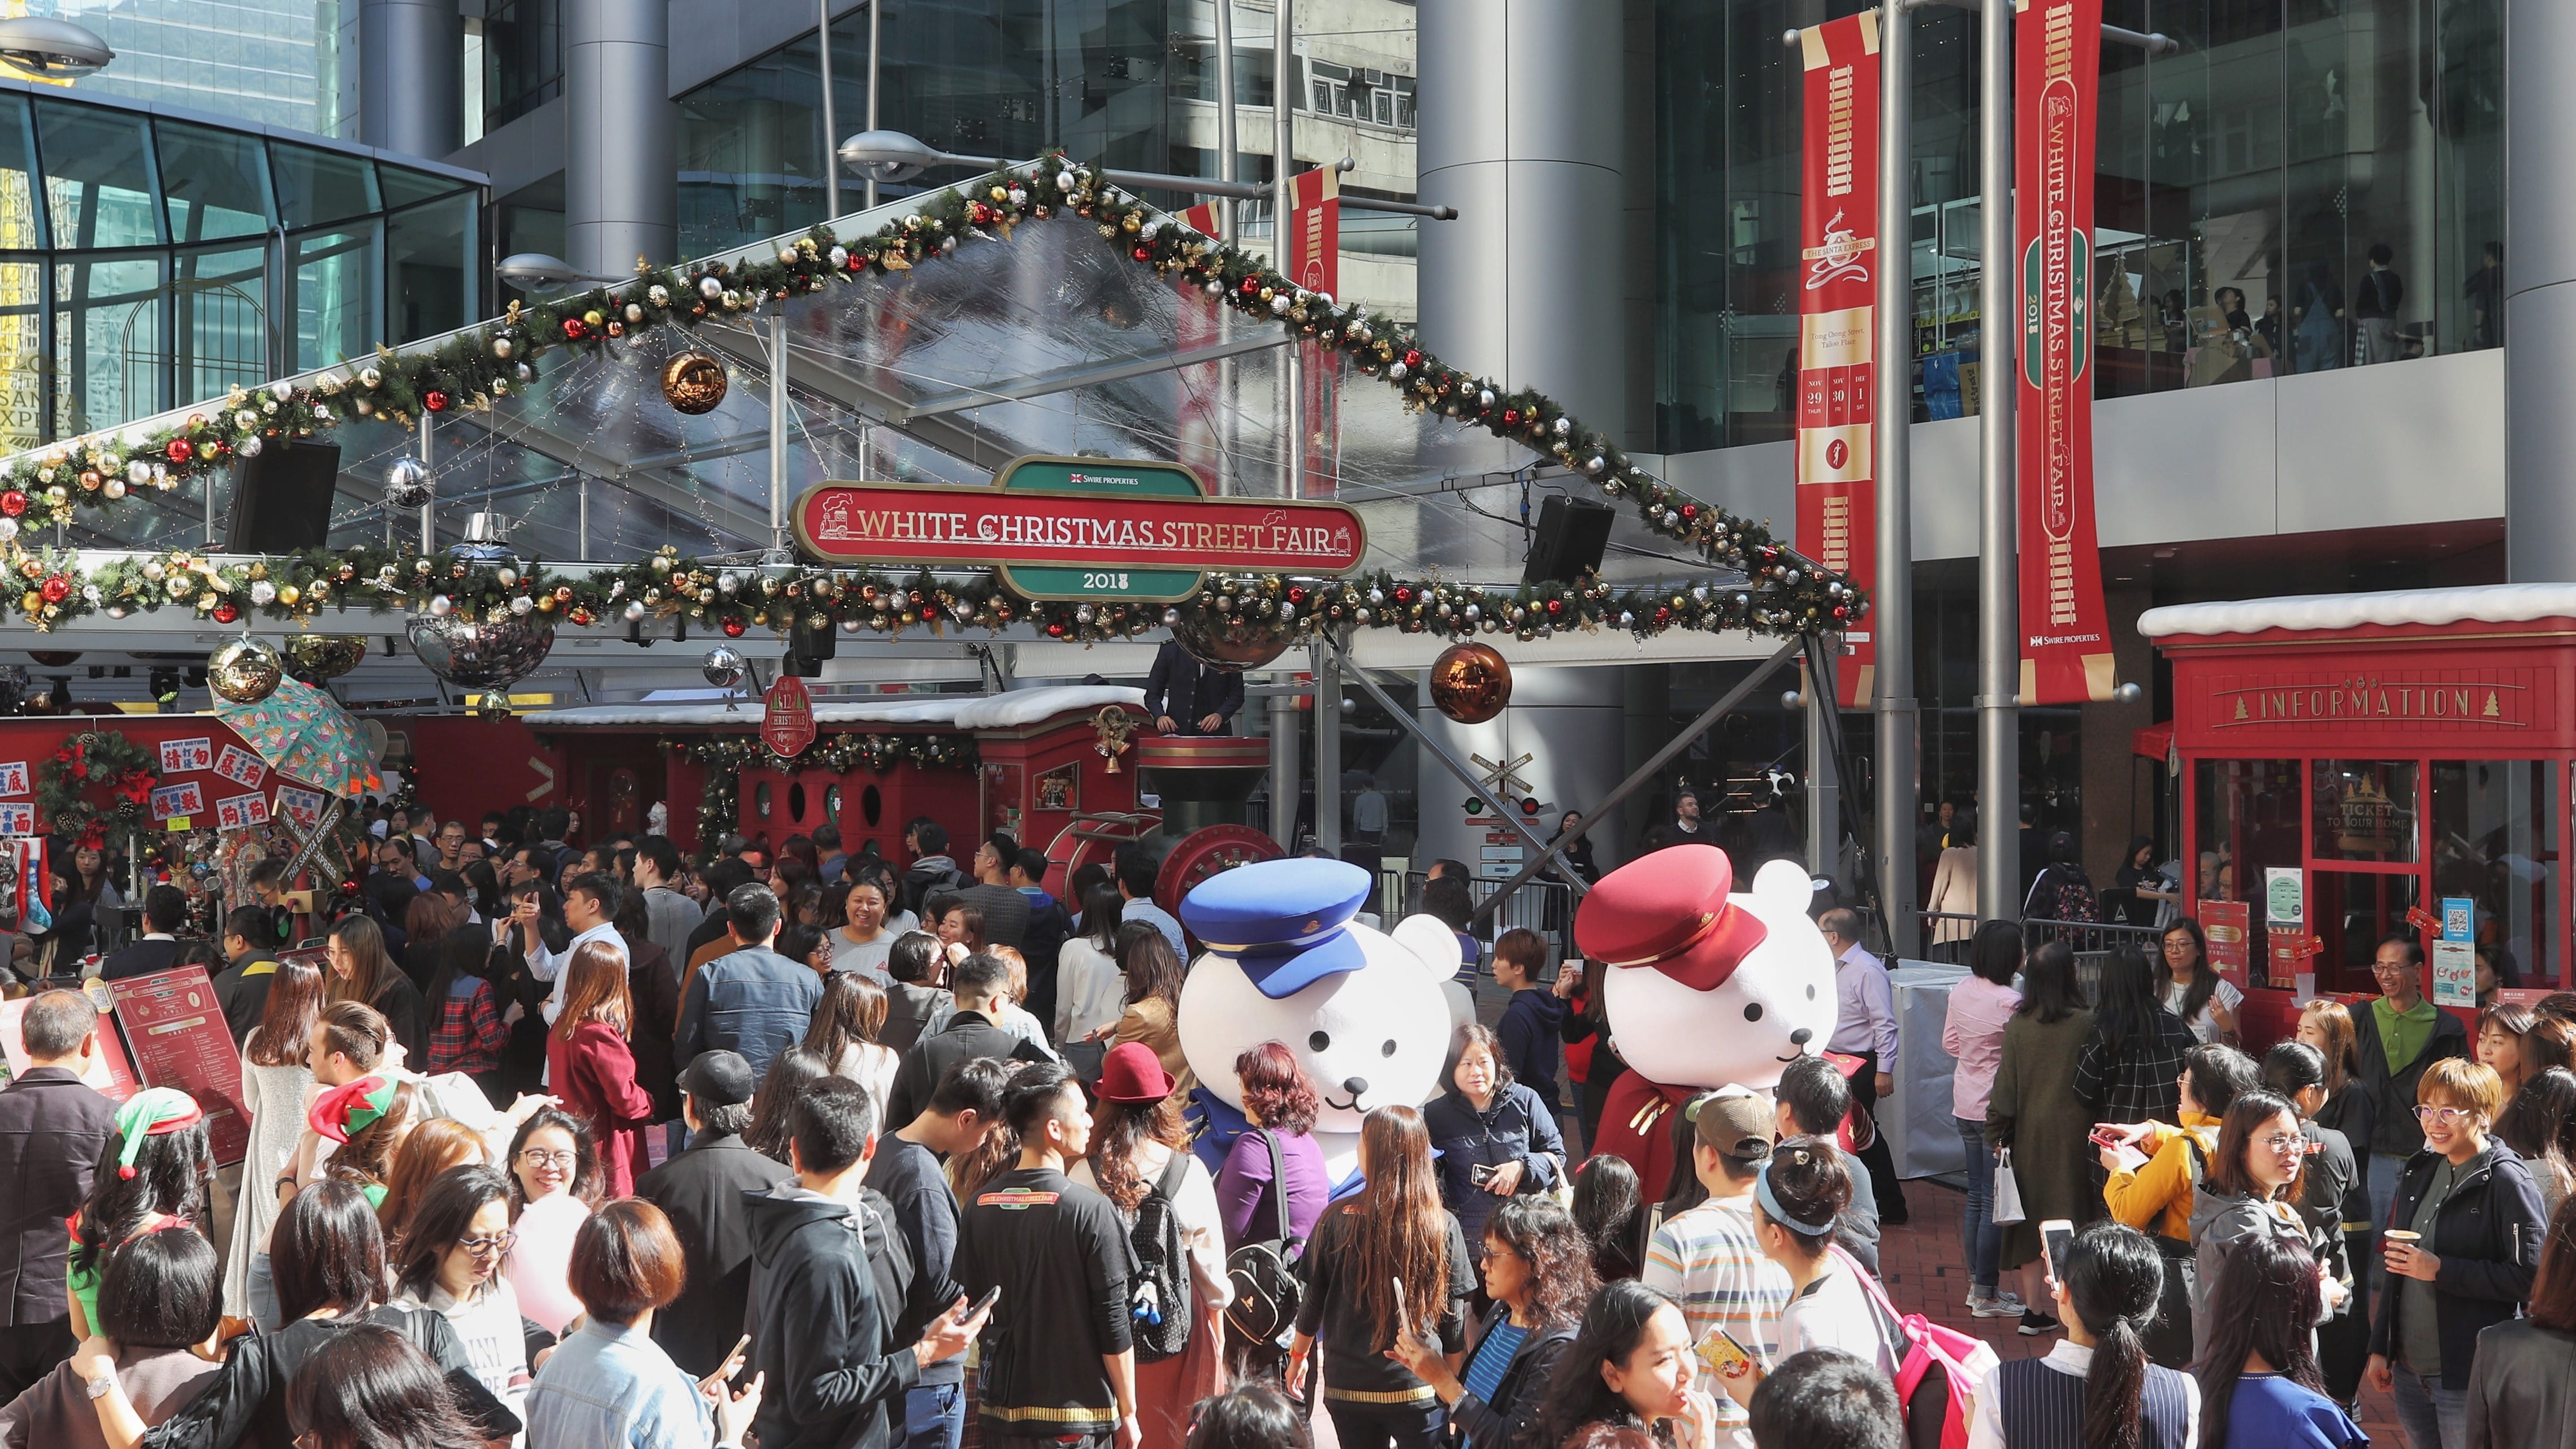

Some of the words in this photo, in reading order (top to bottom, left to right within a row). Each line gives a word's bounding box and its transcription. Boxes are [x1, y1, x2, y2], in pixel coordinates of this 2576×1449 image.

[2050, 121, 2064, 204] WHITE
[1822, 246, 1842, 255] SANTA
[1844, 240, 1871, 251] EXPRESS
[2050, 210, 2064, 353] CHRISTMAS
[1828, 329, 1846, 338] Chong
[0, 389, 80, 411] SANTA
[1807, 392, 1822, 405] 29
[1833, 389, 1845, 402] 30
[1858, 388, 1863, 400] 1
[2050, 358, 2063, 447] STREET
[0, 410, 92, 431] XPRESS
[1083, 475, 1103, 484] SWIRE
[2053, 455, 2064, 508] FAIR
[857, 510, 968, 540] WHITE
[977, 514, 1154, 547] CHRISTMAS
[1162, 521, 1264, 550] STREET
[1272, 526, 1330, 553] FAIR
[1083, 572, 1129, 589] 2018
[2044, 636, 2064, 645] SWIRE
[2064, 634, 2100, 643] PROPERTIES
[783, 694, 791, 709] 12
[2261, 689, 2468, 718] INFORMATION
[770, 715, 805, 726] CHRISTMAS
[164, 749, 182, 770] 請
[193, 748, 209, 765] 勿
[227, 747, 240, 756] DOG
[249, 756, 265, 766] HOME
[242, 765, 262, 786] 狗
[1477, 757, 1488, 767] THE
[1487, 763, 1499, 773] SAN
[1507, 775, 1527, 789] XPRESS
[1487, 770, 1505, 783] SANTA
[1505, 757, 1527, 773] EXPRESS
[7, 770, 26, 792] 底
[221, 805, 239, 826] 狗
[249, 800, 266, 821] 狗
[2340, 804, 2393, 816] TICKET
[14, 813, 31, 832] 面
[2327, 817, 2340, 826] TO
[2344, 818, 2372, 827] YOUR
[2376, 819, 2407, 828] HOME
[283, 810, 296, 830] THE
[295, 826, 308, 843] SAN
[314, 851, 337, 879] XPRESS
[287, 862, 300, 881] THE
[298, 840, 317, 867] SANTA
[315, 809, 339, 843] EXPRESS
